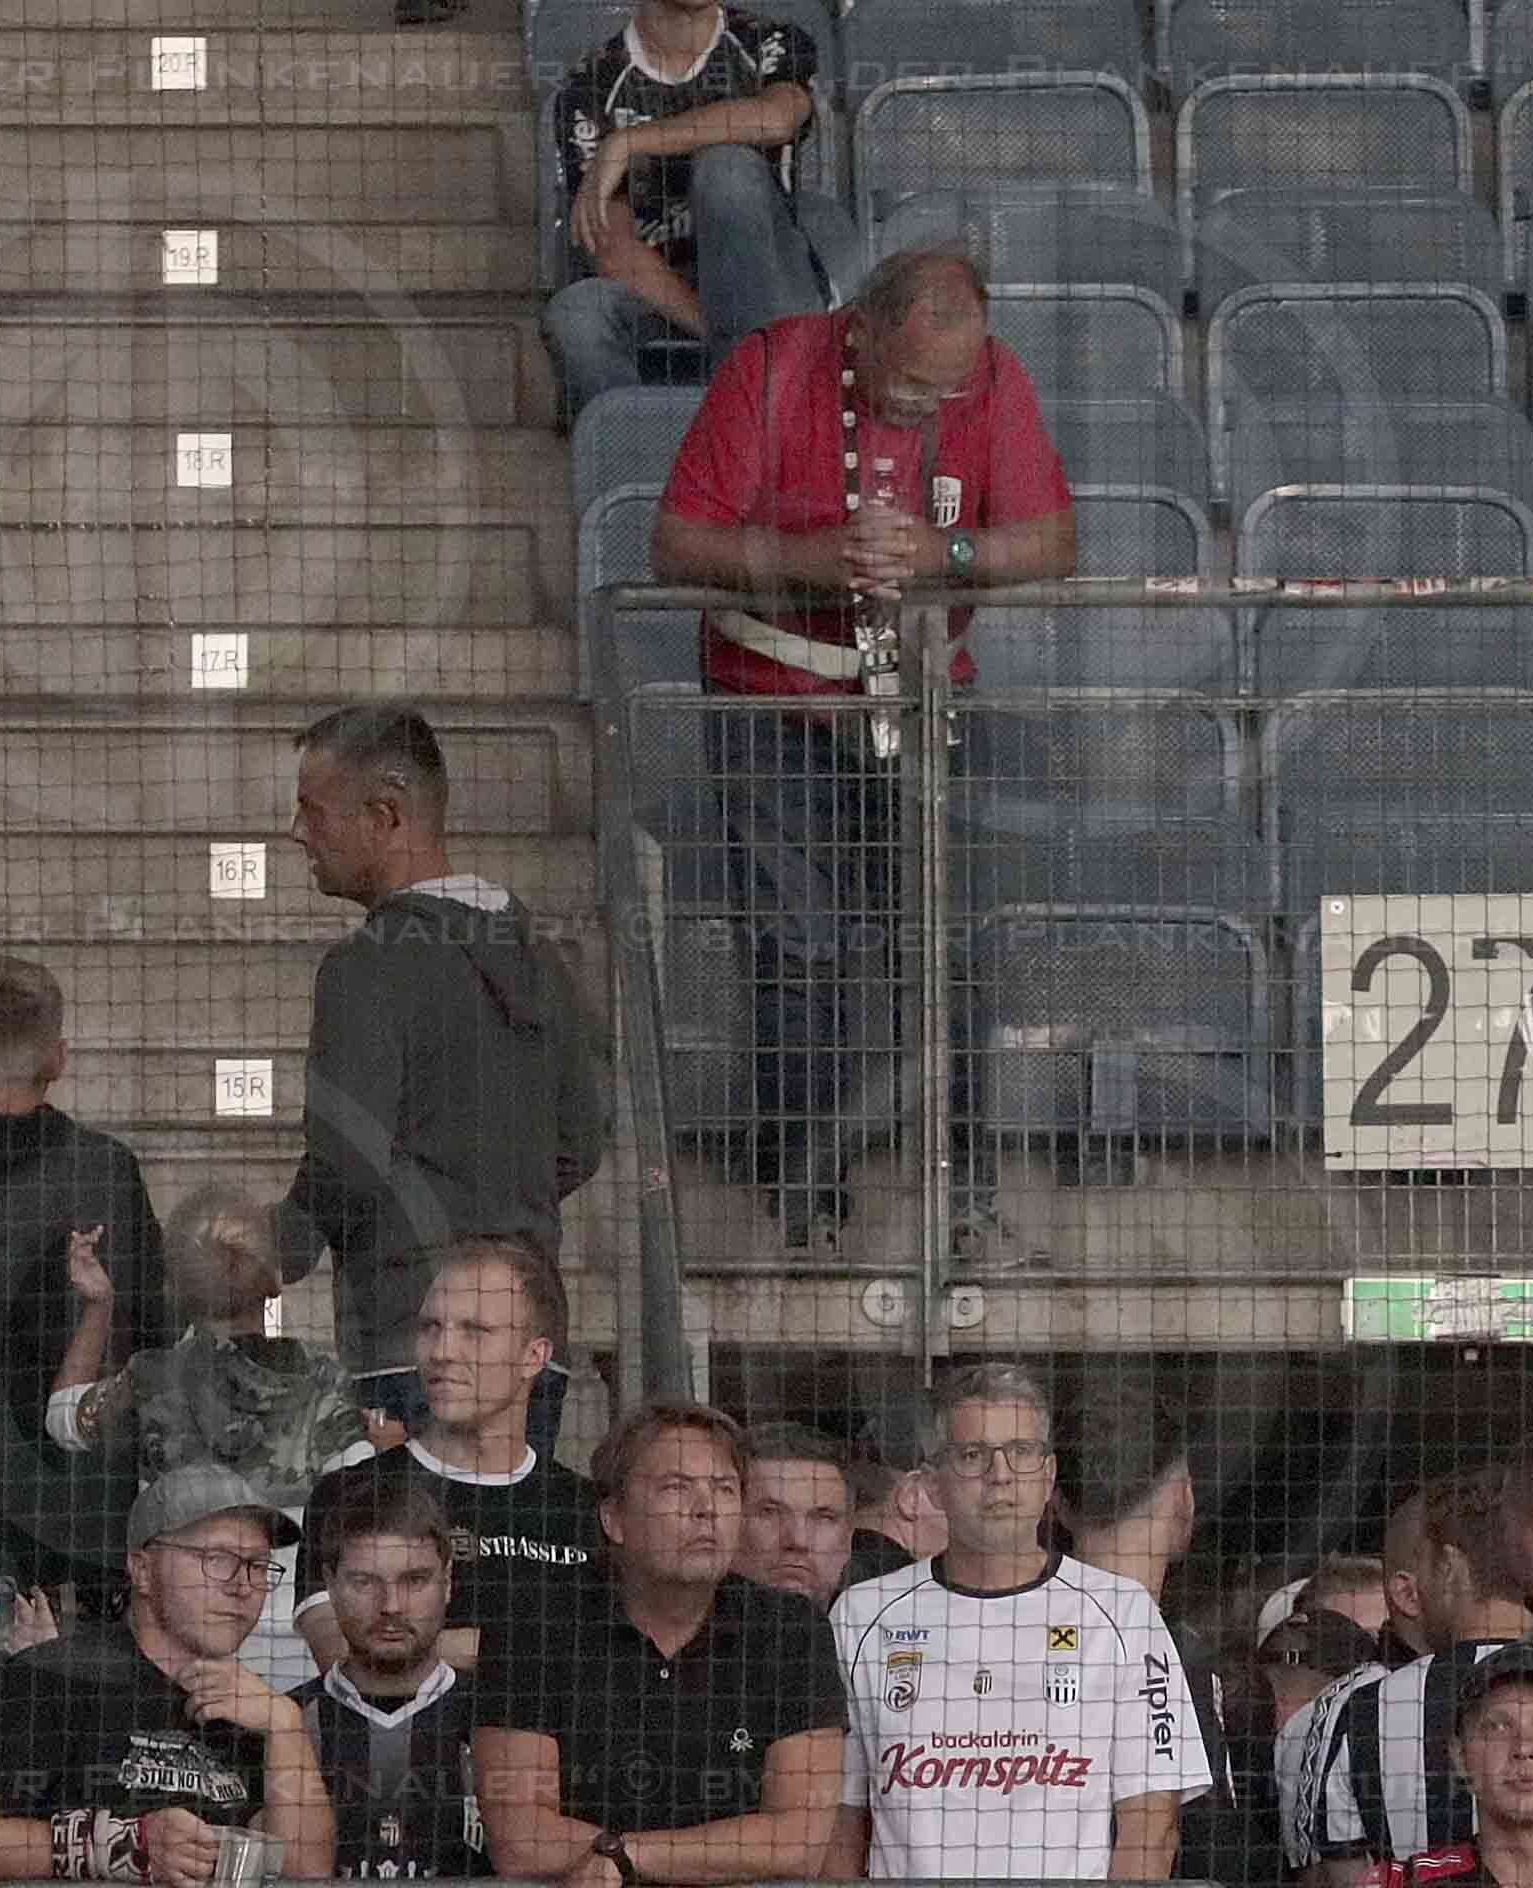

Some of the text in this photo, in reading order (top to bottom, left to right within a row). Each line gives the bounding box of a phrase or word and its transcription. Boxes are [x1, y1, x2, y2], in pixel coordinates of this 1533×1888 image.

[170, 246, 209, 266] 19.R
[183, 452, 225, 472] 18.R
[215, 858, 257, 880] 16.R
[223, 1076, 263, 1097] 15.R
[1137, 1650, 1176, 1763] Zipfer
[931, 1729, 1041, 1750] backaldrin
[880, 1742, 1094, 1796] Kornspitz
